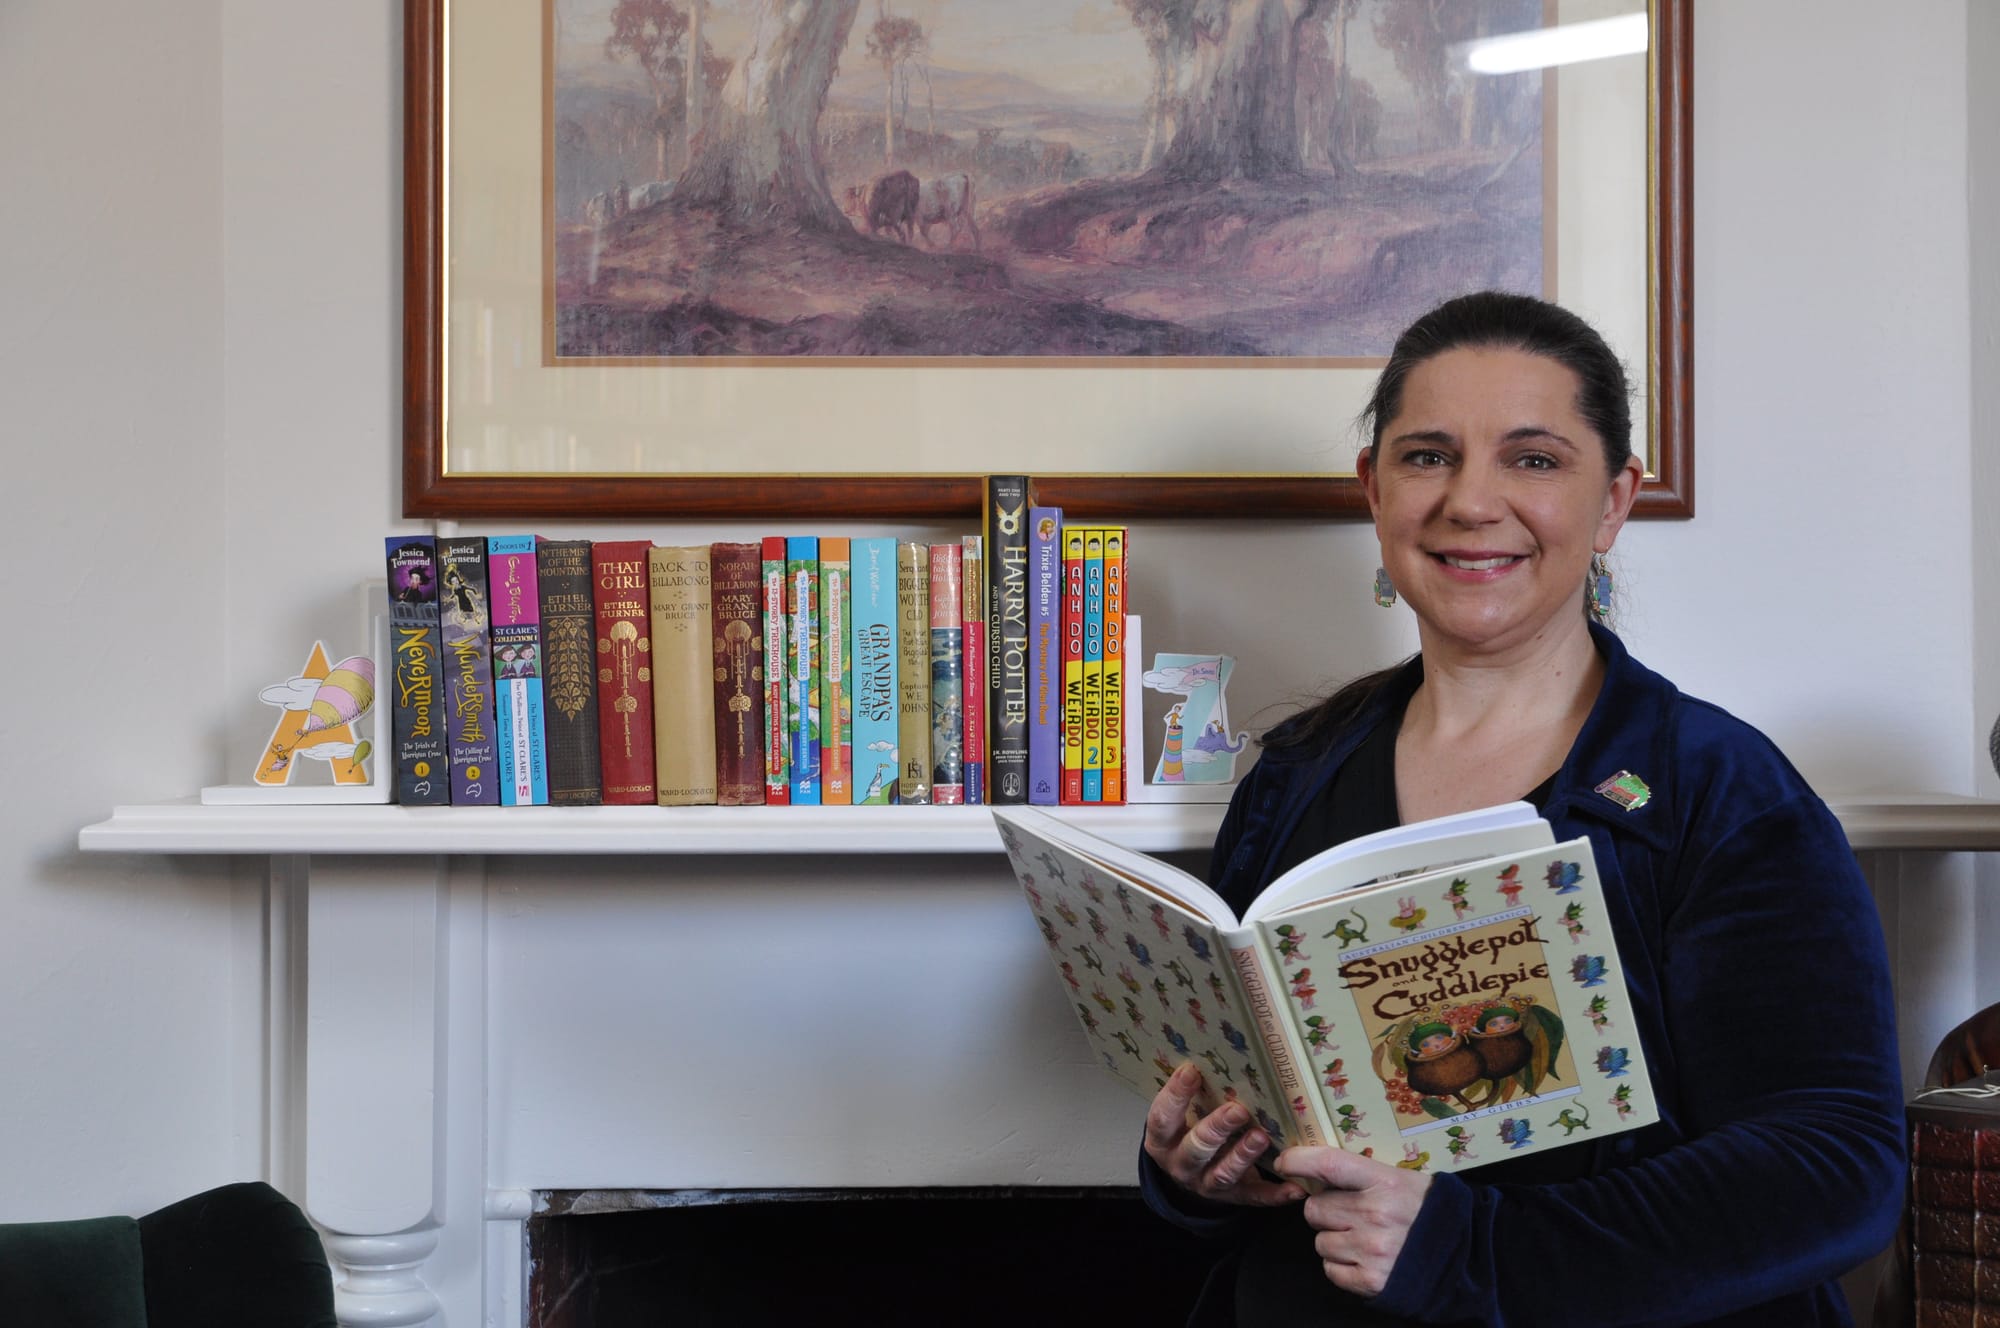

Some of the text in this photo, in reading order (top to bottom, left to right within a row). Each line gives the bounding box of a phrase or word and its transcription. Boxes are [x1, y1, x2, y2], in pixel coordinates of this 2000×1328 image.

[449, 546, 474, 556] Jessica
[492, 542, 499, 553] 3
[527, 542, 531, 550] 1
[549, 548, 568, 557] THE
[398, 548, 424, 560] Jessica
[442, 554, 480, 566] Townsend
[392, 558, 430, 568] Townsend
[548, 557, 581, 566] OF THE
[652, 561, 708, 573] BACK TO
[720, 562, 754, 571] NORAH
[899, 561, 928, 574] Sergant
[598, 562, 642, 574] THAT
[652, 576, 709, 587] BILLABONG
[730, 572, 742, 580] OF
[1040, 545, 1052, 616] Trixie Belden #5
[601, 576, 644, 589] GIRL
[1002, 546, 1027, 630] HARRY
[548, 594, 587, 604] ETHEL
[721, 594, 752, 603] MARY
[542, 603, 592, 613] TURNER
[604, 601, 640, 610] ETHEL
[653, 603, 710, 612] MARY GRANT
[717, 602, 758, 611] GRANT
[600, 610, 645, 618] TURNER
[665, 612, 695, 620] BRUCE
[720, 610, 756, 619] BRUCE
[506, 626, 538, 635] CLARE'S
[991, 614, 1000, 653] CURSED
[1040, 623, 1049, 636] The
[771, 627, 779, 678] TREEHOUSE
[800, 626, 808, 677] TREEHOUSE
[831, 628, 839, 679] TREEHOUSE
[1038, 638, 1049, 670] Mystery
[858, 629, 872, 717] GREAT ESCAPE
[869, 624, 892, 721] GRANDPA'S
[992, 656, 1000, 689] CHILD
[1003, 635, 1028, 732] POTTER
[901, 703, 928, 713] JOHNS
[519, 740, 525, 749] ST
[1088, 746, 1098, 765] 2
[1106, 746, 1117, 764] 3
[420, 766, 424, 774] 1
[519, 750, 527, 782] CLARE'S
[1344, 909, 1529, 960] AUSTRALIAN CHILDREN'S CLASSICS
[1337, 916, 1549, 989] Snugglepot
[1392, 975, 1418, 987] and
[1373, 962, 1549, 1020] Cuddlepie
[1236, 950, 1299, 1090] SNUGGLEPOT AND CUDDLEPIE
[1450, 1100, 1532, 1123] MAY GIBBS
[1304, 1123, 1315, 1140] MAY
